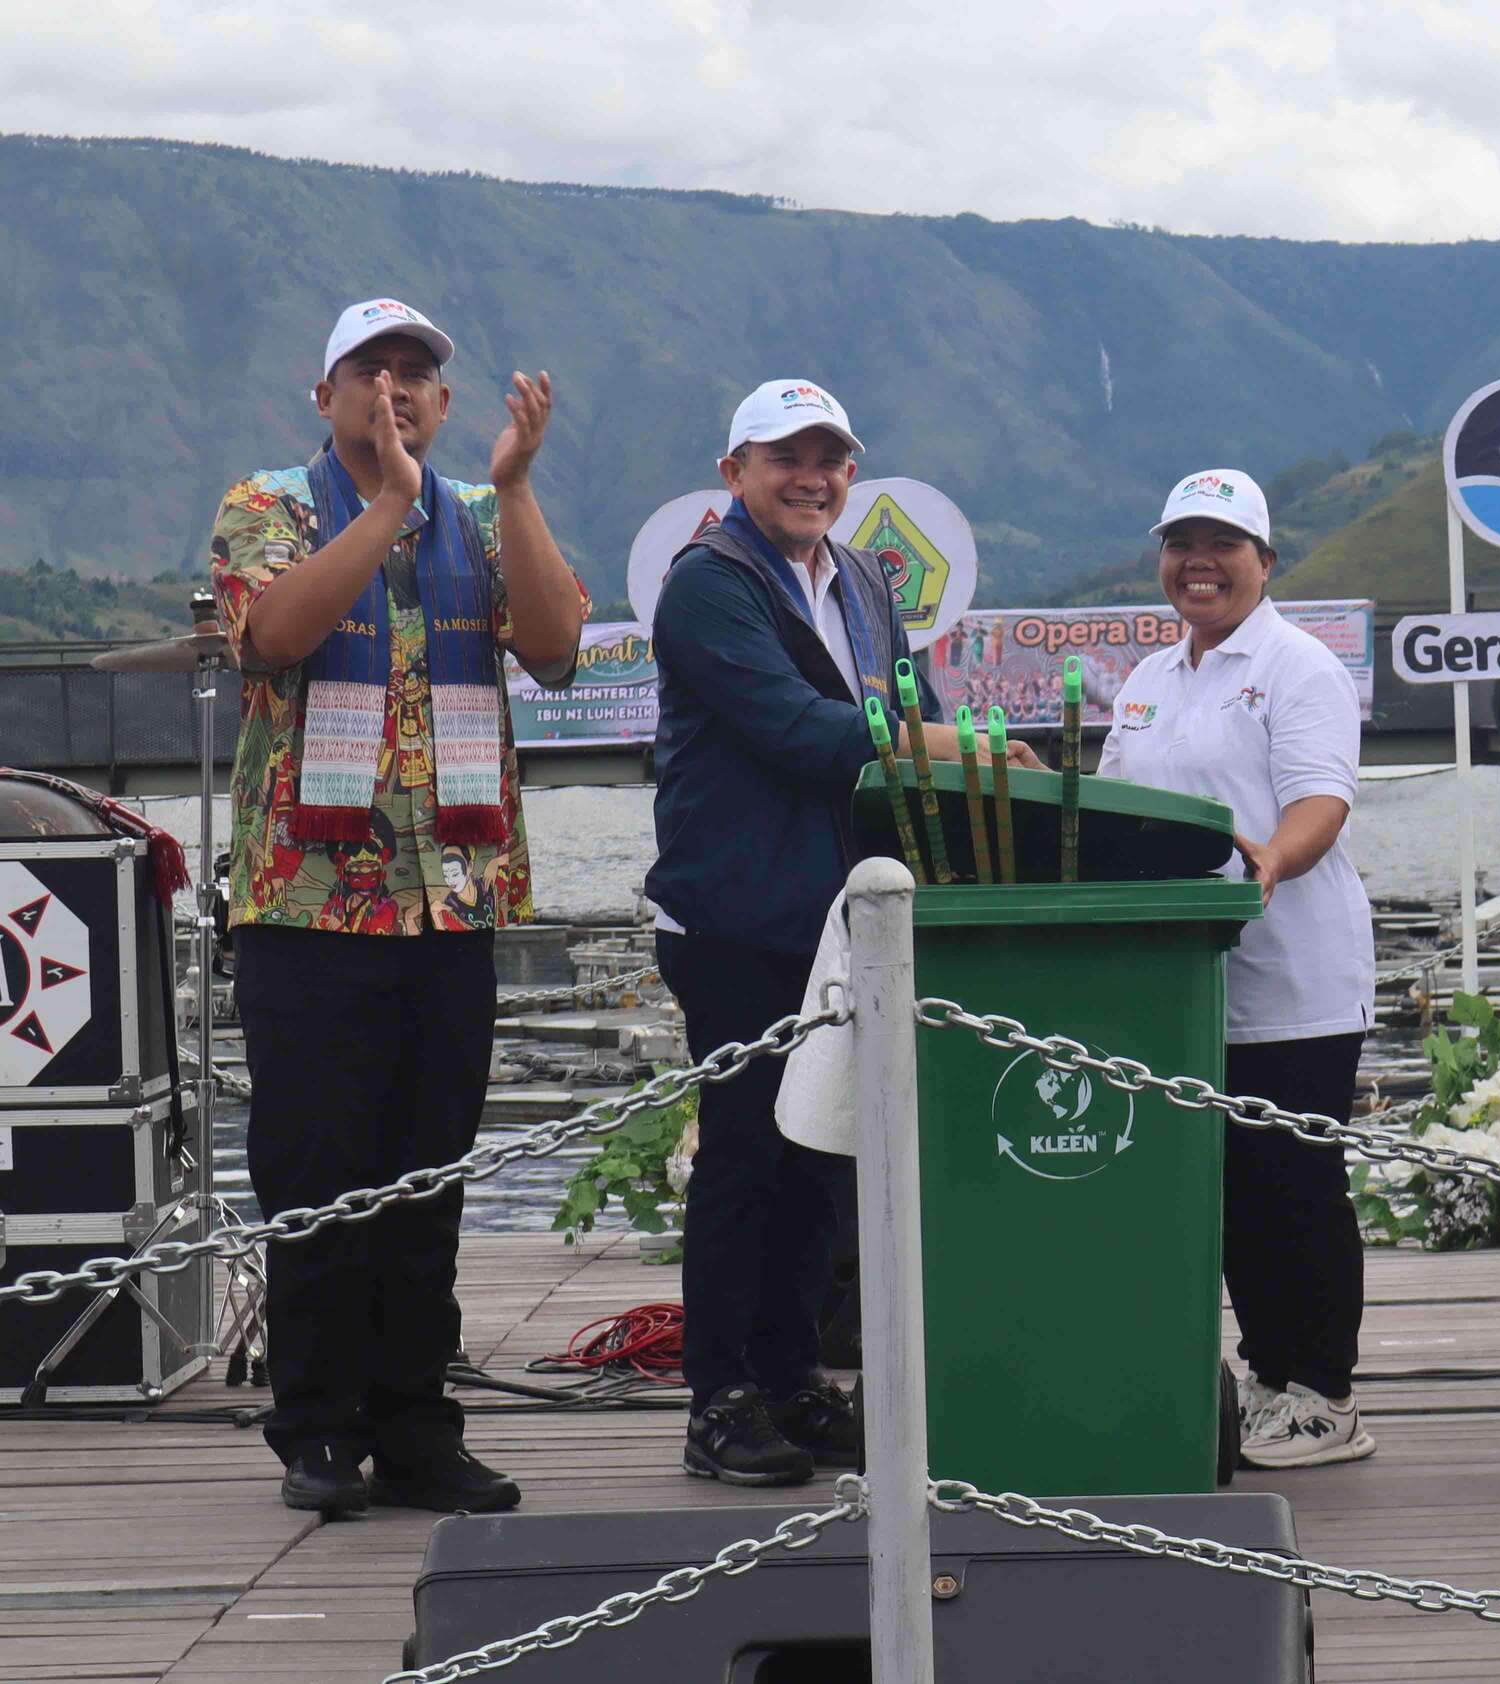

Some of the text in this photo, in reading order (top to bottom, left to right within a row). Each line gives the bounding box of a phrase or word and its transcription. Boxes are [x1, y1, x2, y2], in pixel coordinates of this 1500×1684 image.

[335, 619, 377, 637] ORAS
[1015, 616, 1128, 653] Opera
[576, 635, 640, 669] amat
[521, 689, 568, 702] WAKIL
[572, 687, 634, 700] MENTERI
[536, 708, 561, 721] IBU
[565, 708, 584, 721] NI
[586, 707, 614, 720] LUH
[618, 706, 653, 719] ENIK
